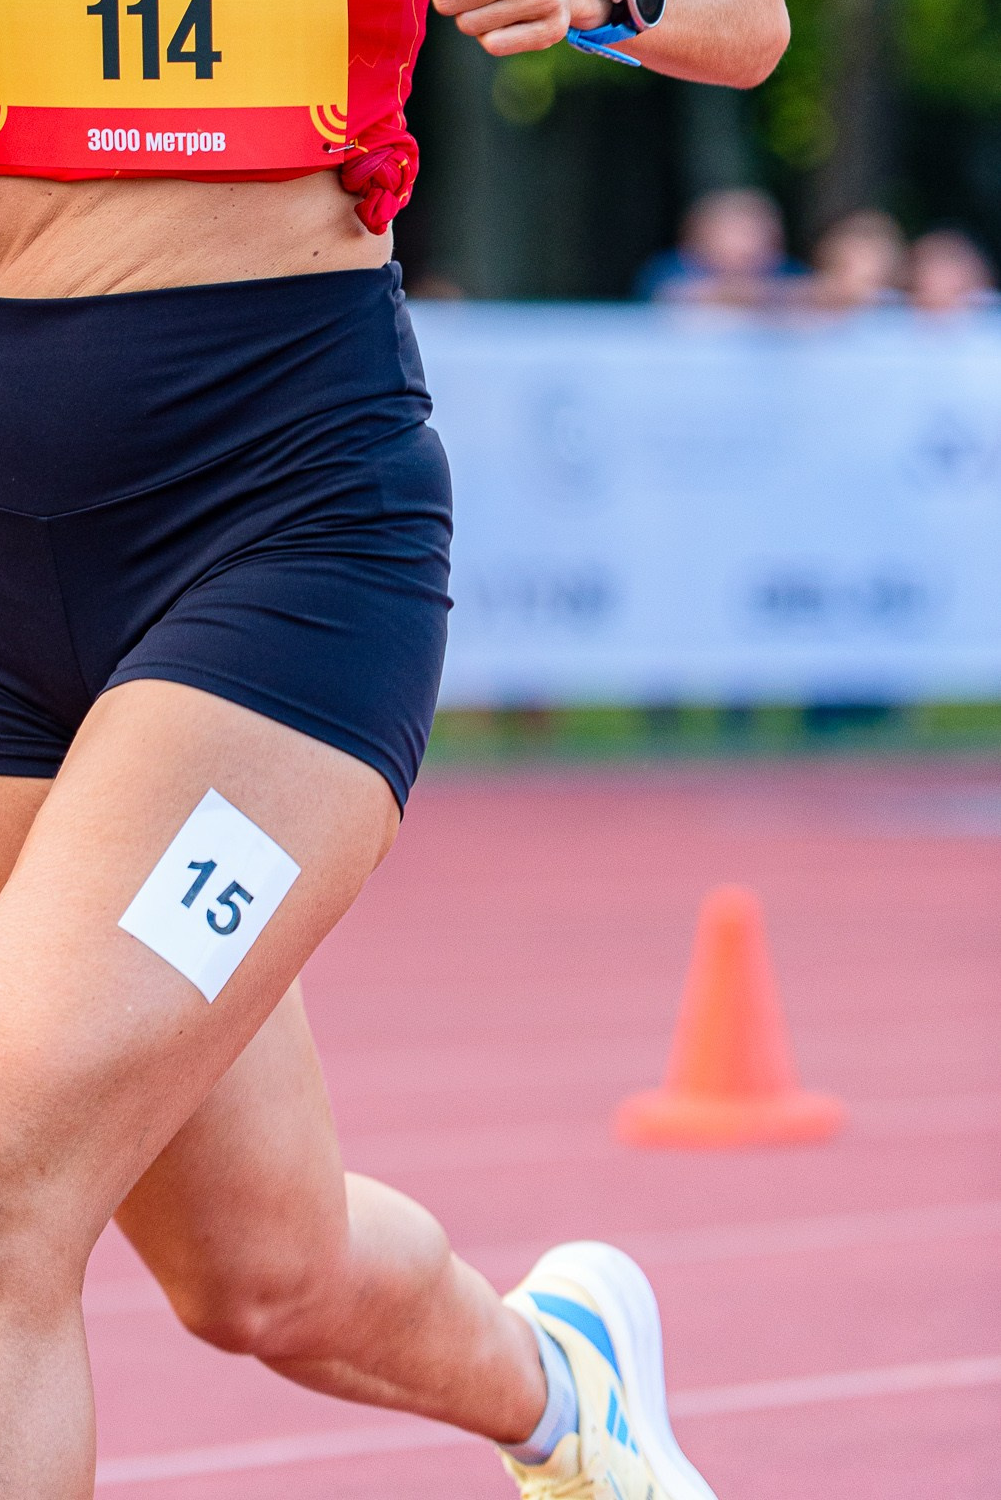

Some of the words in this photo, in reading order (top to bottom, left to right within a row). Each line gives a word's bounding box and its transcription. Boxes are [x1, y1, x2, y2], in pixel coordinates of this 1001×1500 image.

[87, 128, 140, 152] 3000
[145, 129, 226, 155] метров
[181, 859, 254, 936] 15
